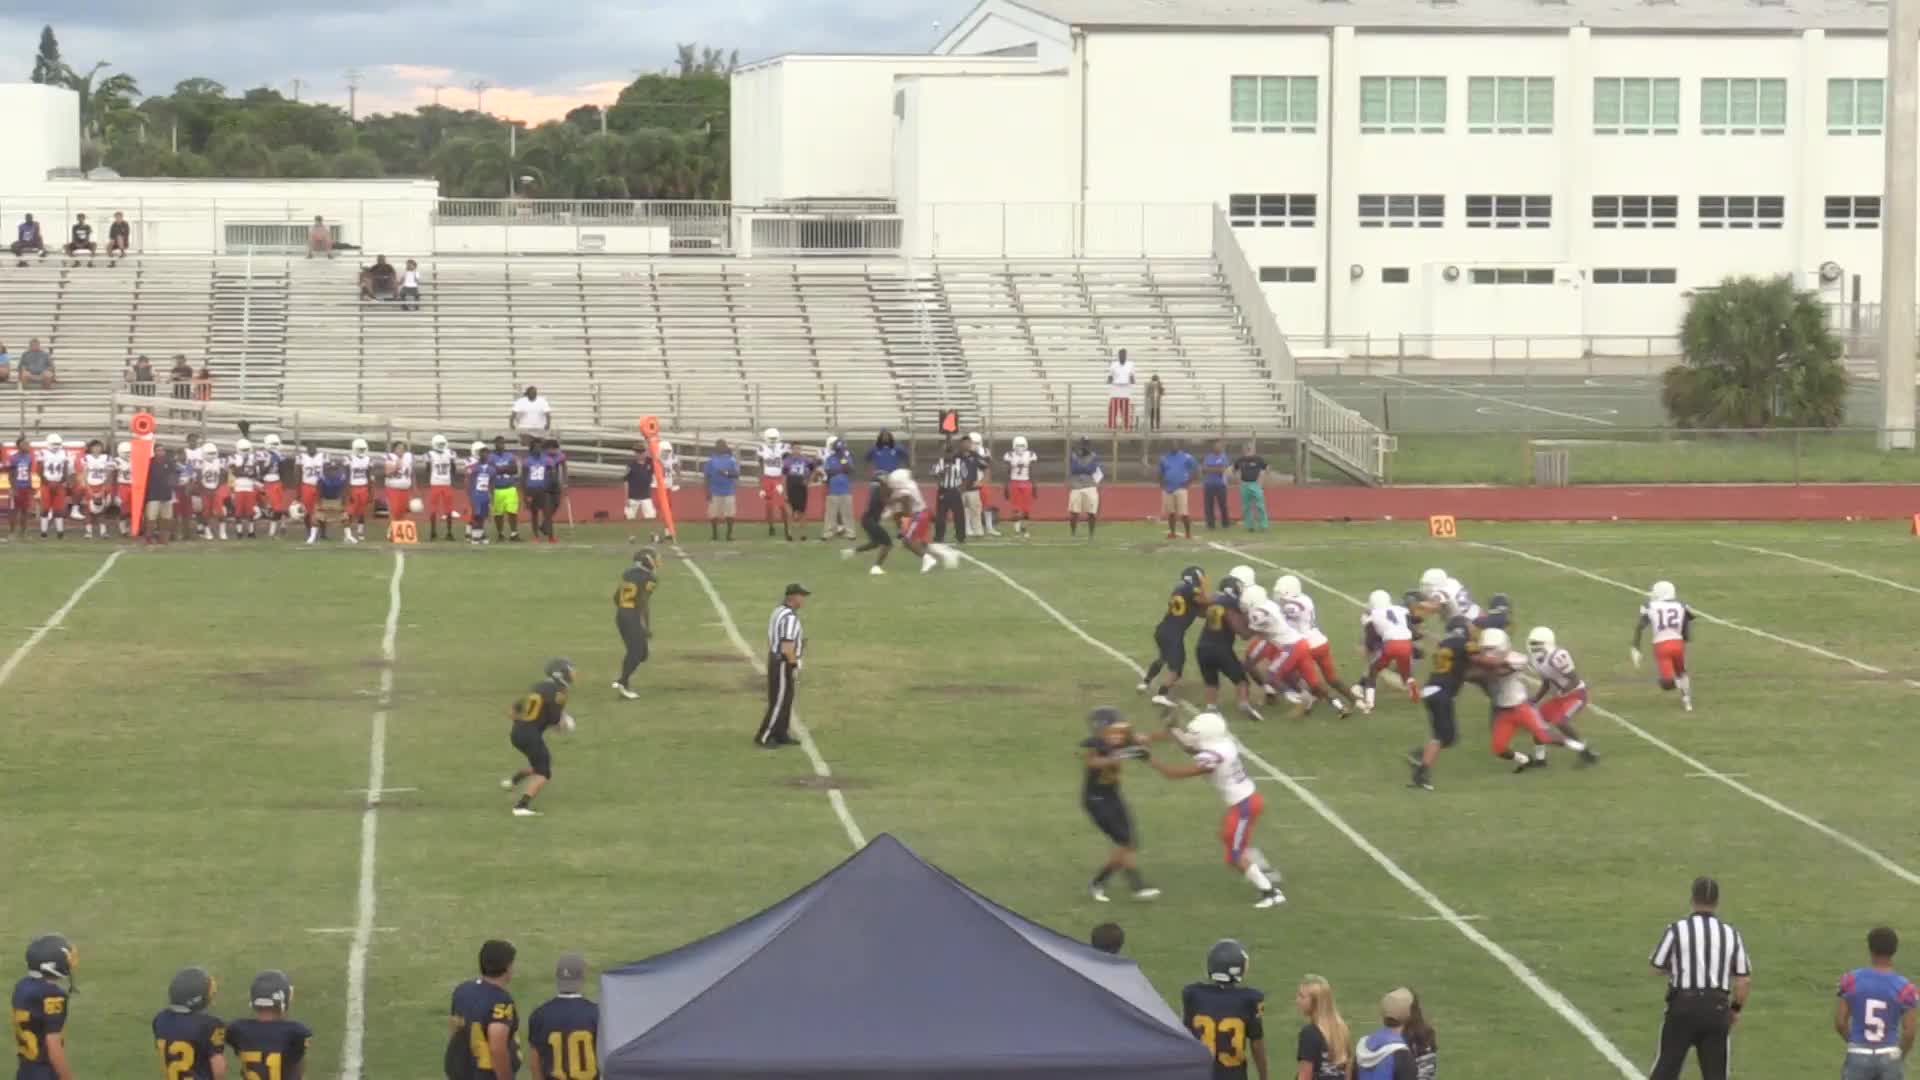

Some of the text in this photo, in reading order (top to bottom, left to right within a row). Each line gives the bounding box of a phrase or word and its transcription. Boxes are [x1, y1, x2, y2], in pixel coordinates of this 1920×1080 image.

[47, 463, 62, 475] 44
[396, 524, 414, 540] 40
[1433, 519, 1453, 535] 20
[1656, 608, 1679, 630] 12
[493, 1003, 513, 1019] 54
[1864, 998, 1888, 1042] 5
[548, 1030, 597, 1080] 10
[239, 1050, 281, 1080] 51
